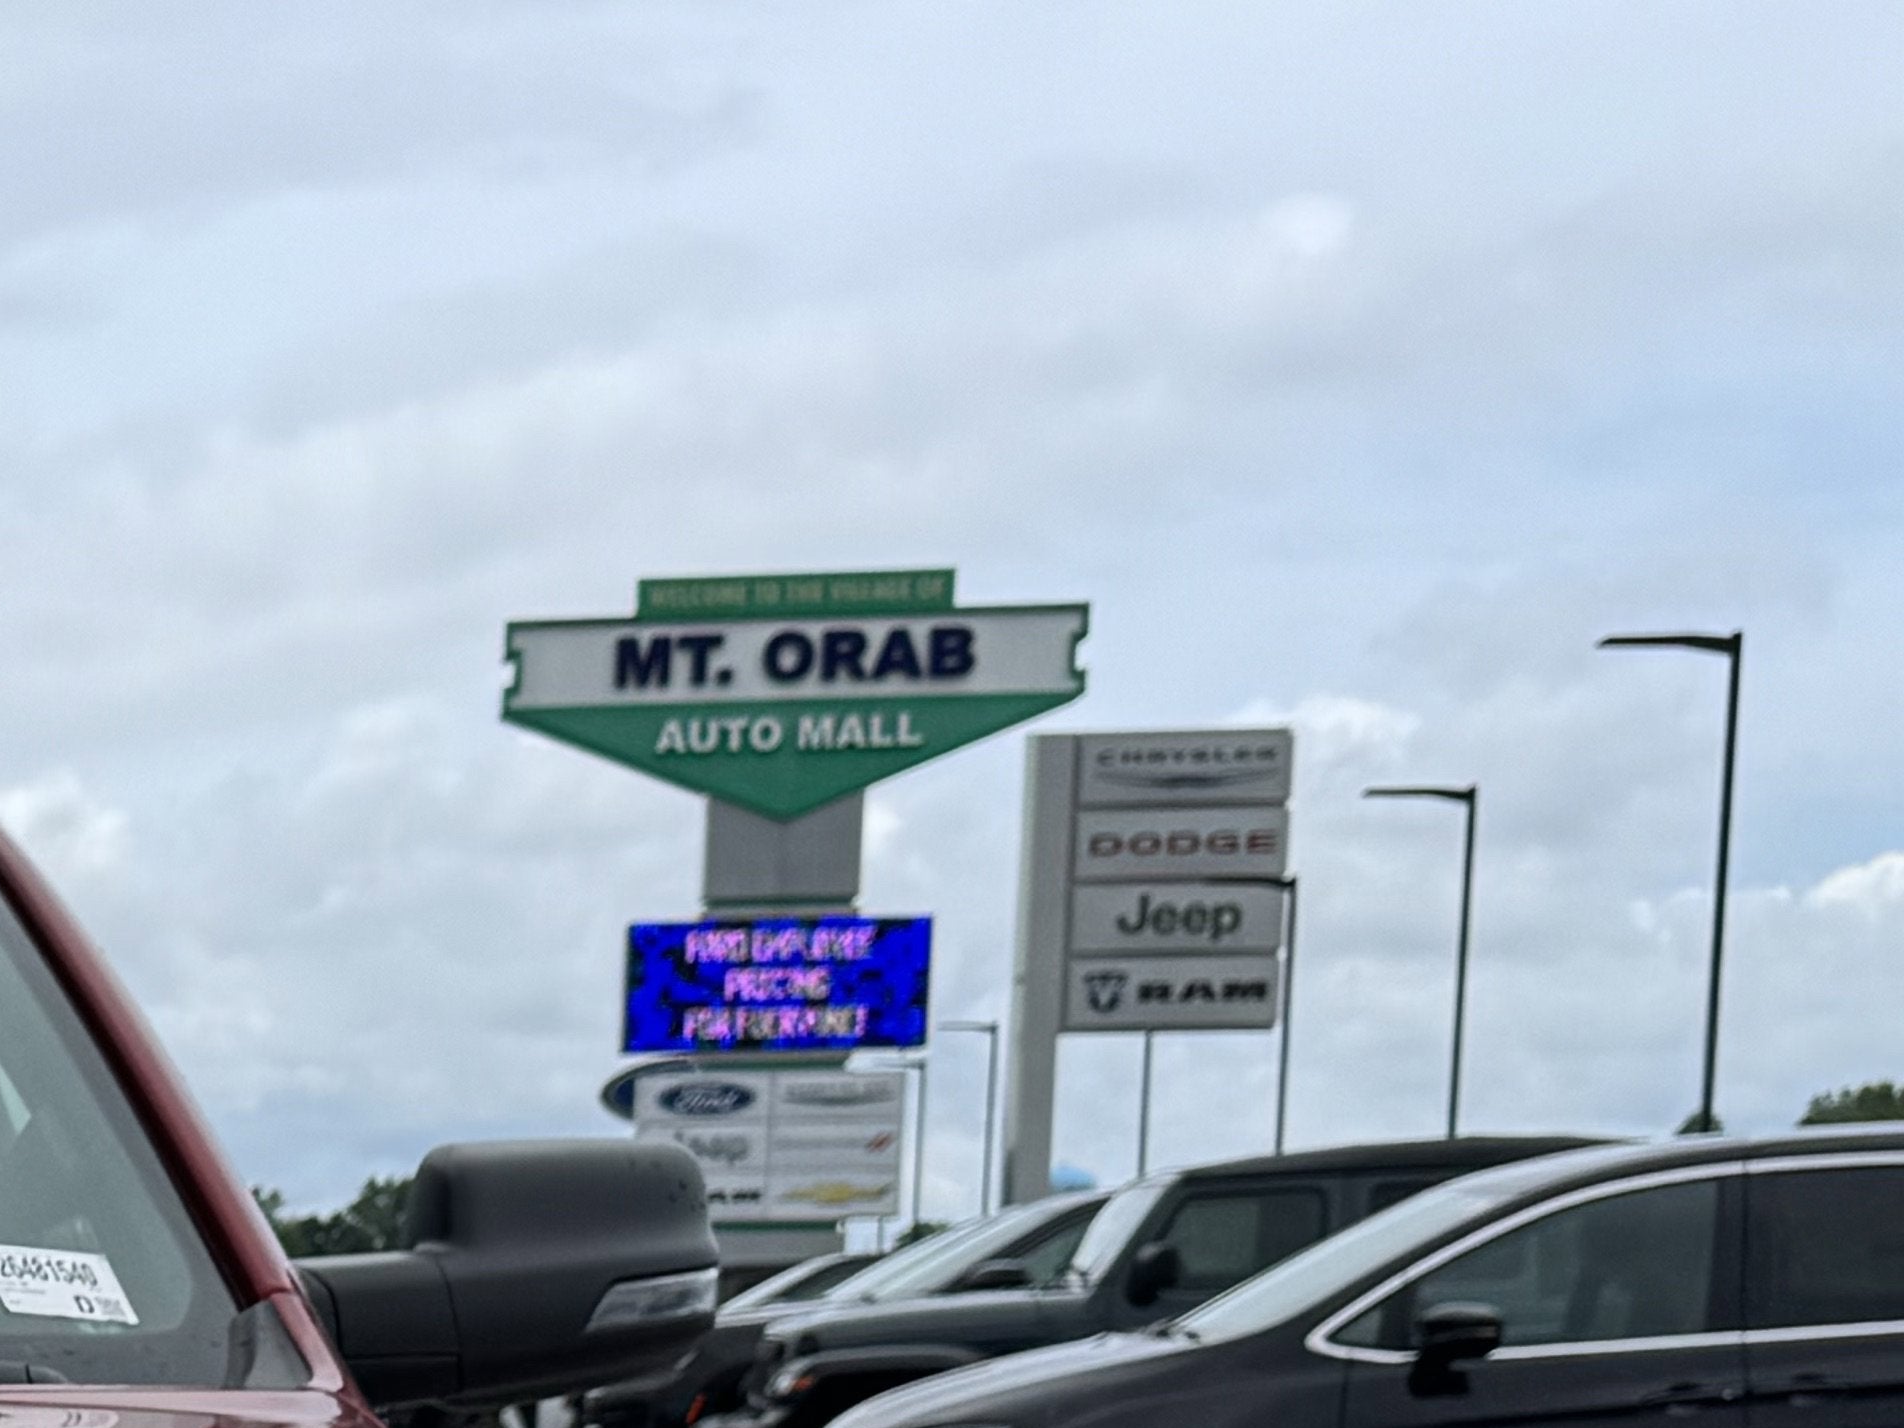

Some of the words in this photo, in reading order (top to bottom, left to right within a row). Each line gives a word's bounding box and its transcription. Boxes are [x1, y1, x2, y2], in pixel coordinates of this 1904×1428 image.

[614, 634, 734, 690] MT.
[763, 625, 975, 683] ORAB
[655, 718, 782, 755] AUTO
[797, 712, 924, 750] MALL
[1096, 746, 1277, 767] CHRYSLER
[1089, 829, 1277, 858] DODGE
[1116, 893, 1241, 941] Jeep
[1138, 979, 1267, 1004] RAM
